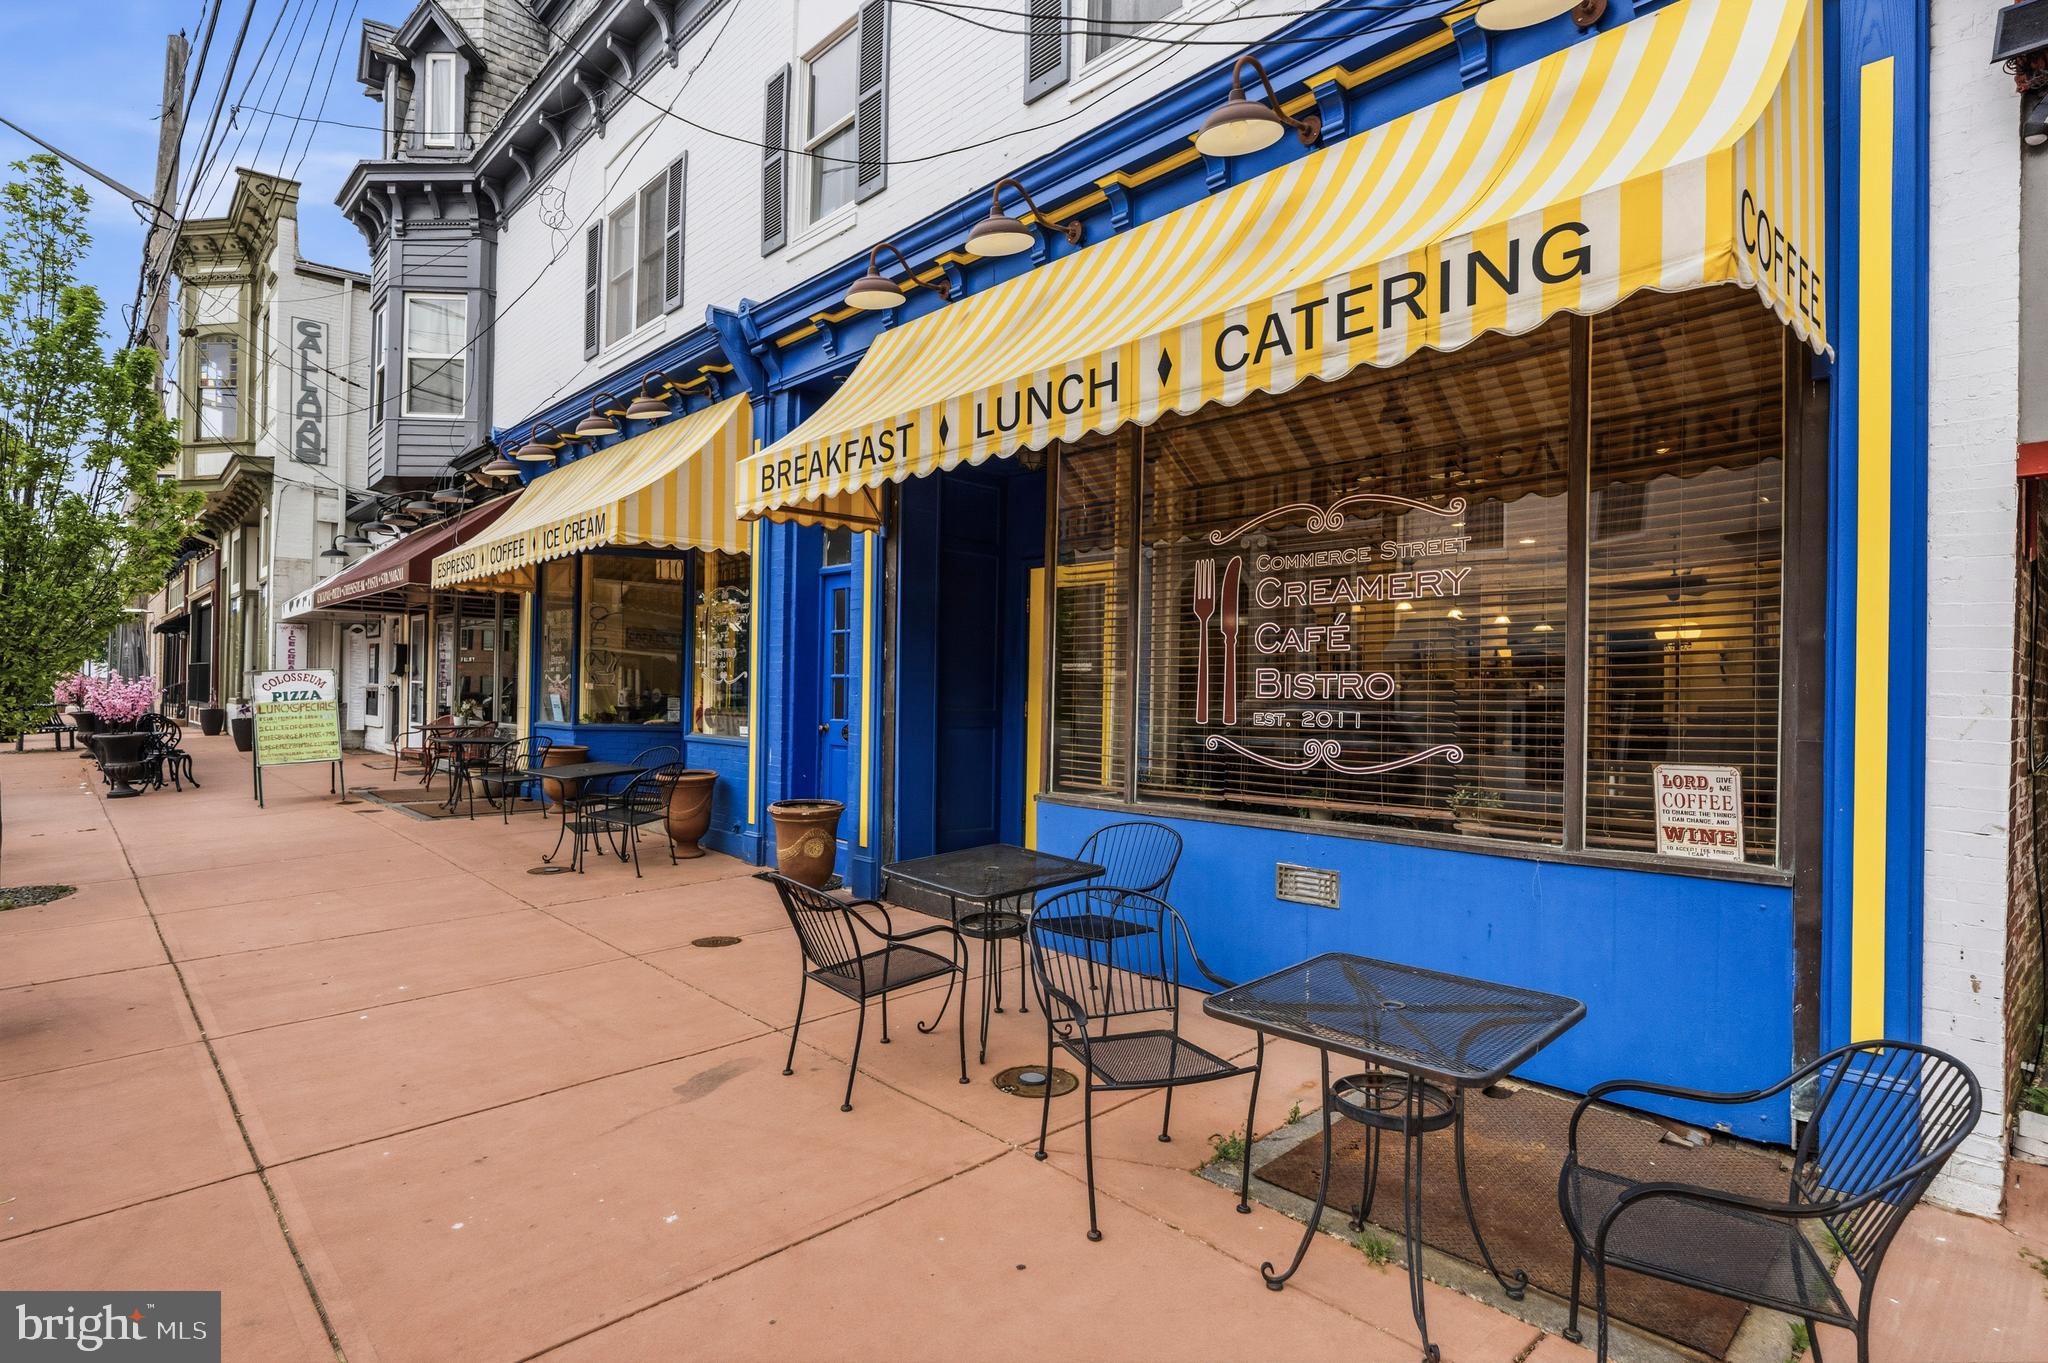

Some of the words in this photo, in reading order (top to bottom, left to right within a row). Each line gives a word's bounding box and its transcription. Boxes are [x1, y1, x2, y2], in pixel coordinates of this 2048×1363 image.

[1741, 189, 1821, 329] COFFEE
[760, 422, 915, 493] BREAKFAST
[976, 361, 1119, 438] LUNCH
[1214, 220, 1591, 373] CATERING
[437, 553, 476, 579] ESPRESSO
[489, 538, 525, 565] COFFEE
[543, 526, 560, 550] ICE
[563, 512, 606, 544] CREAM
[1256, 546, 1372, 572] COMMERCE
[1380, 536, 1472, 560] STREET
[656, 559, 685, 581] 110
[1255, 567, 1472, 609] CREAMERY
[1254, 612, 1351, 654] CAFÉ
[262, 672, 327, 691] COLOSSEUM
[1255, 667, 1395, 700] BISTRO
[271, 689, 322, 702] PIZZA
[1301, 711, 1361, 728] 2011
[1662, 774, 1714, 793] LORD,
[1715, 776, 1733, 784] GIVE
[1662, 791, 1734, 811] COFFEE
[1671, 809, 1696, 817] CHANGE
[1662, 826, 1738, 847] WINE
